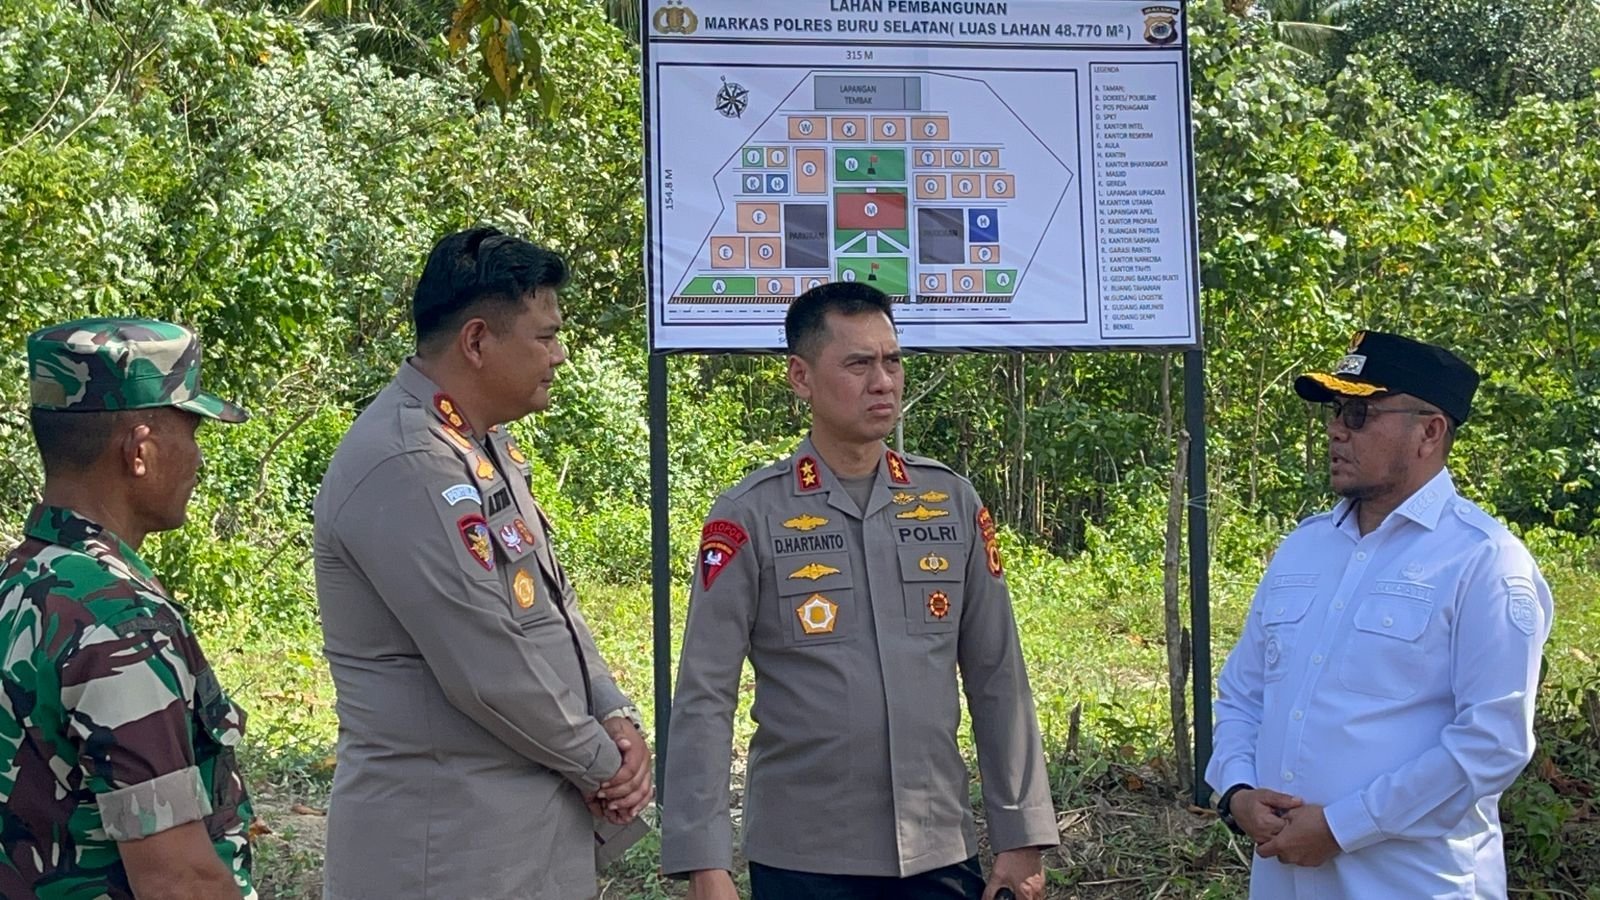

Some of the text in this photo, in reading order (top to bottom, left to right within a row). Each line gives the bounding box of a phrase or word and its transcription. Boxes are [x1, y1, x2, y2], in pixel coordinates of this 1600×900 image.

[830, 0, 1007, 16] LAHAN PEMBANGUNAN
[705, 17, 769, 31] MARKAS
[774, 18, 833, 32] POLRES
[838, 19, 879, 33] BURU
[959, 22, 997, 36] LUAS
[1001, 23, 1050, 37] LAHAN
[1055, 24, 1101, 38] 48.770
[846, 51, 873, 60] 315 M
[840, 85, 877, 94] LAPANGAN
[844, 96, 872, 105] TEMBAK
[802, 123, 810, 131] W
[886, 125, 892, 134] Y
[925, 154, 931, 162] T
[955, 154, 961, 163] U
[982, 154, 989, 163] V
[806, 165, 813, 173] G
[750, 180, 756, 188] K
[774, 180, 781, 188] H
[963, 182, 969, 191] R
[997, 182, 1003, 191] S
[665, 169, 674, 210] 154,8 M
[867, 205, 875, 214] M
[757, 213, 762, 221] F
[980, 218, 987, 226] H
[723, 249, 729, 257] E
[762, 248, 769, 256] D
[982, 249, 988, 258] P
[929, 278, 935, 287] C
[1000, 275, 1006, 283] A
[716, 282, 722, 291] A
[772, 282, 777, 291] B
[899, 526, 957, 543] POLRI
[774, 534, 844, 554] D.HARTANTO
